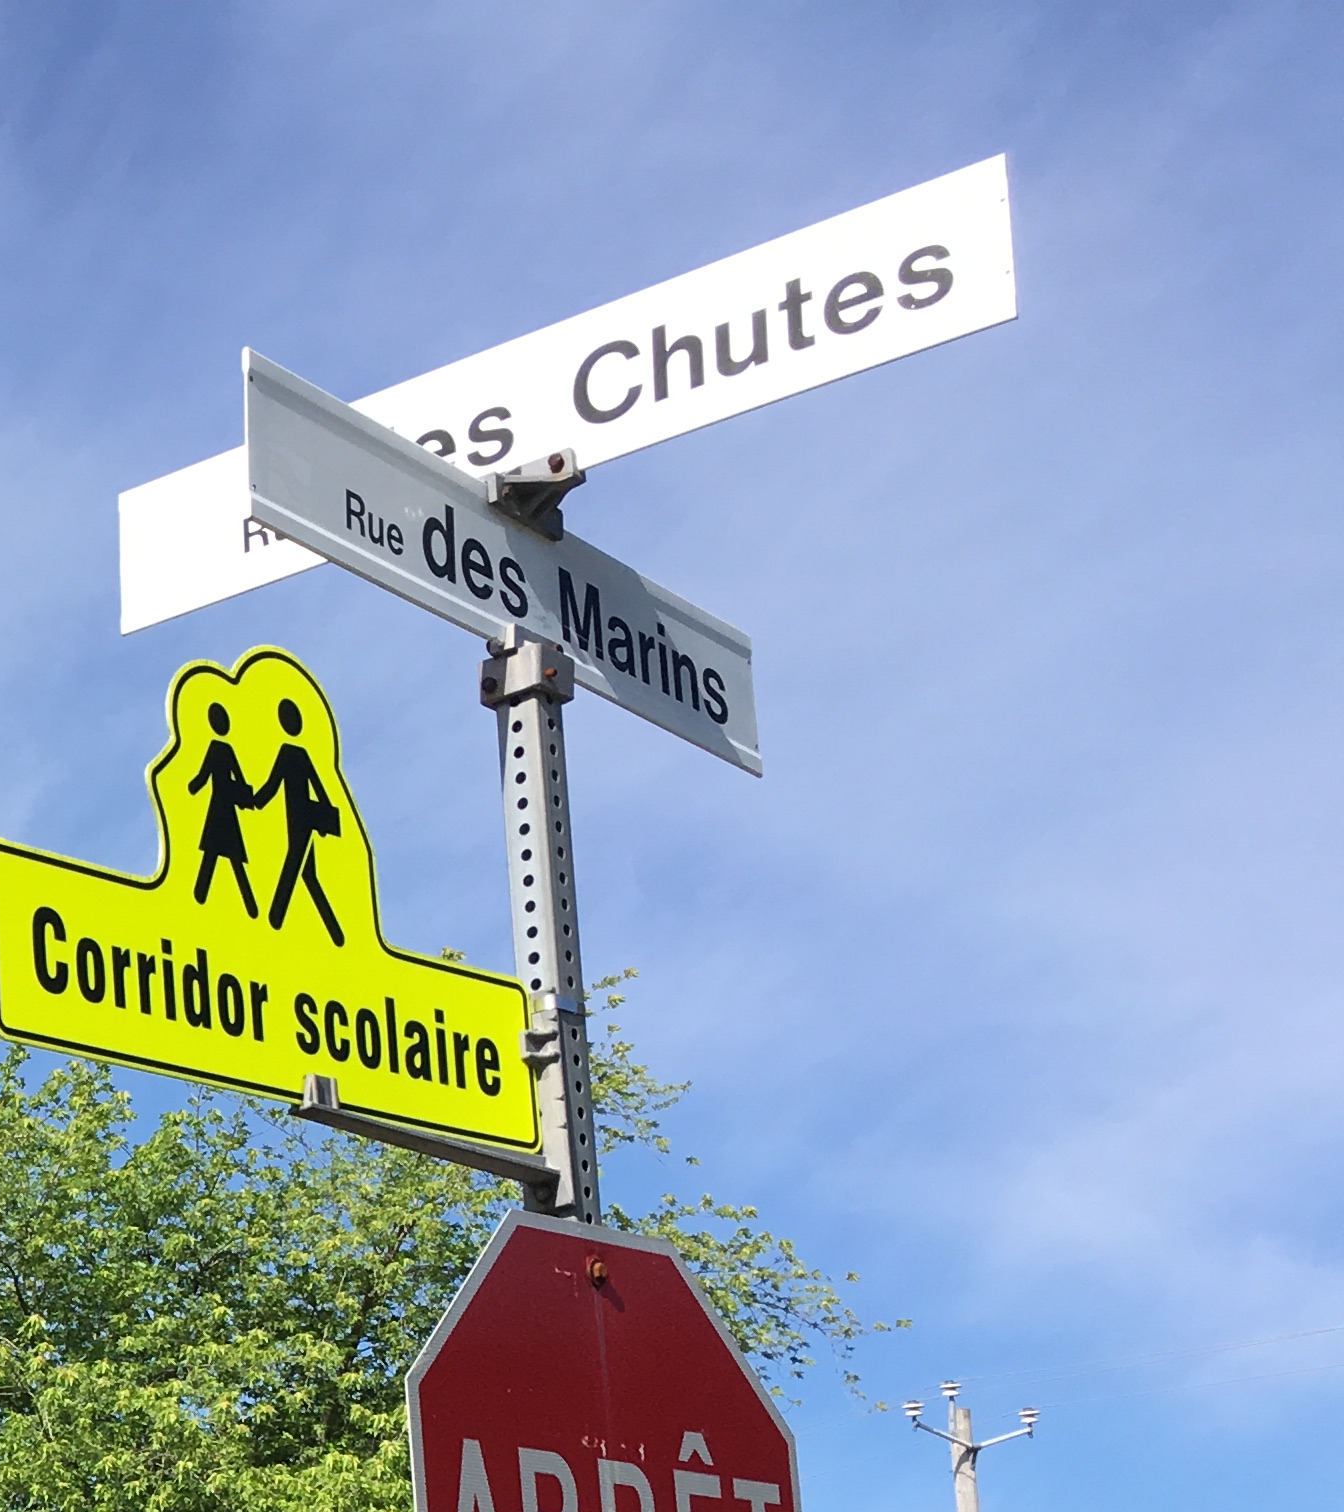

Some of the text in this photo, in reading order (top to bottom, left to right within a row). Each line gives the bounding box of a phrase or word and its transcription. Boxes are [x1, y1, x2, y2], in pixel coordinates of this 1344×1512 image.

[573, 244, 954, 423] Chutes
[345, 488, 728, 725] Rue des Marins
[31, 906, 502, 1096] Corridor scolaire
